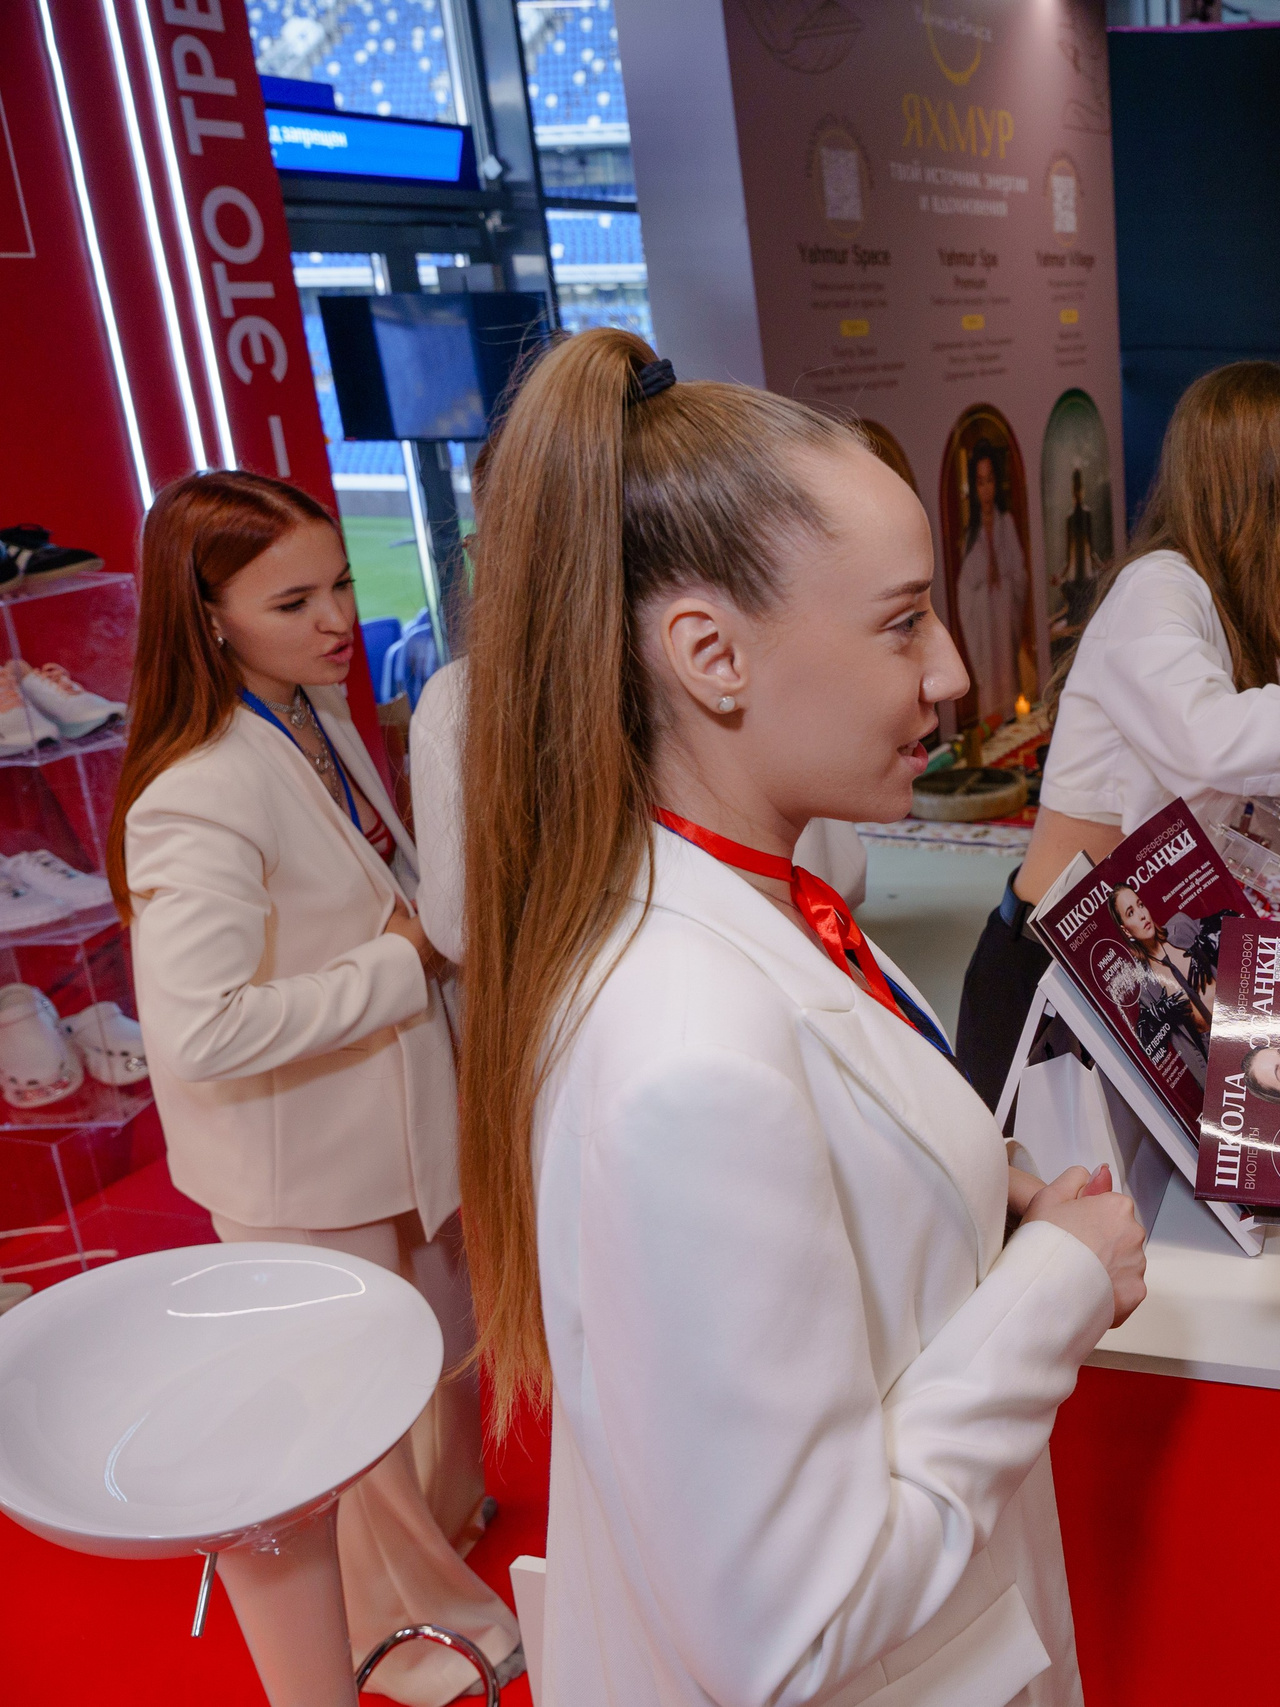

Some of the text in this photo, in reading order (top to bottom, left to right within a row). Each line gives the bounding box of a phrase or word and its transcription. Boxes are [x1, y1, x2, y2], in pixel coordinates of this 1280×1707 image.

[901, 93, 1014, 159] ЯХМУР
[201, 186, 289, 384] ЭТО
[1134, 817, 1186, 862] ФЕРЕФЕРОВОЙ
[1055, 877, 1115, 941] ШКОЛА
[1068, 920, 1098, 952] ВИОЛЕТТЫ
[1097, 946, 1116, 970] УМНЫЙ
[1237, 933, 1253, 1014] ФЕРЕФЕРОВОЙ
[1144, 1021, 1171, 1056] ОТ ПЕРВОГО
[1214, 1070, 1247, 1188] ШКОЛА
